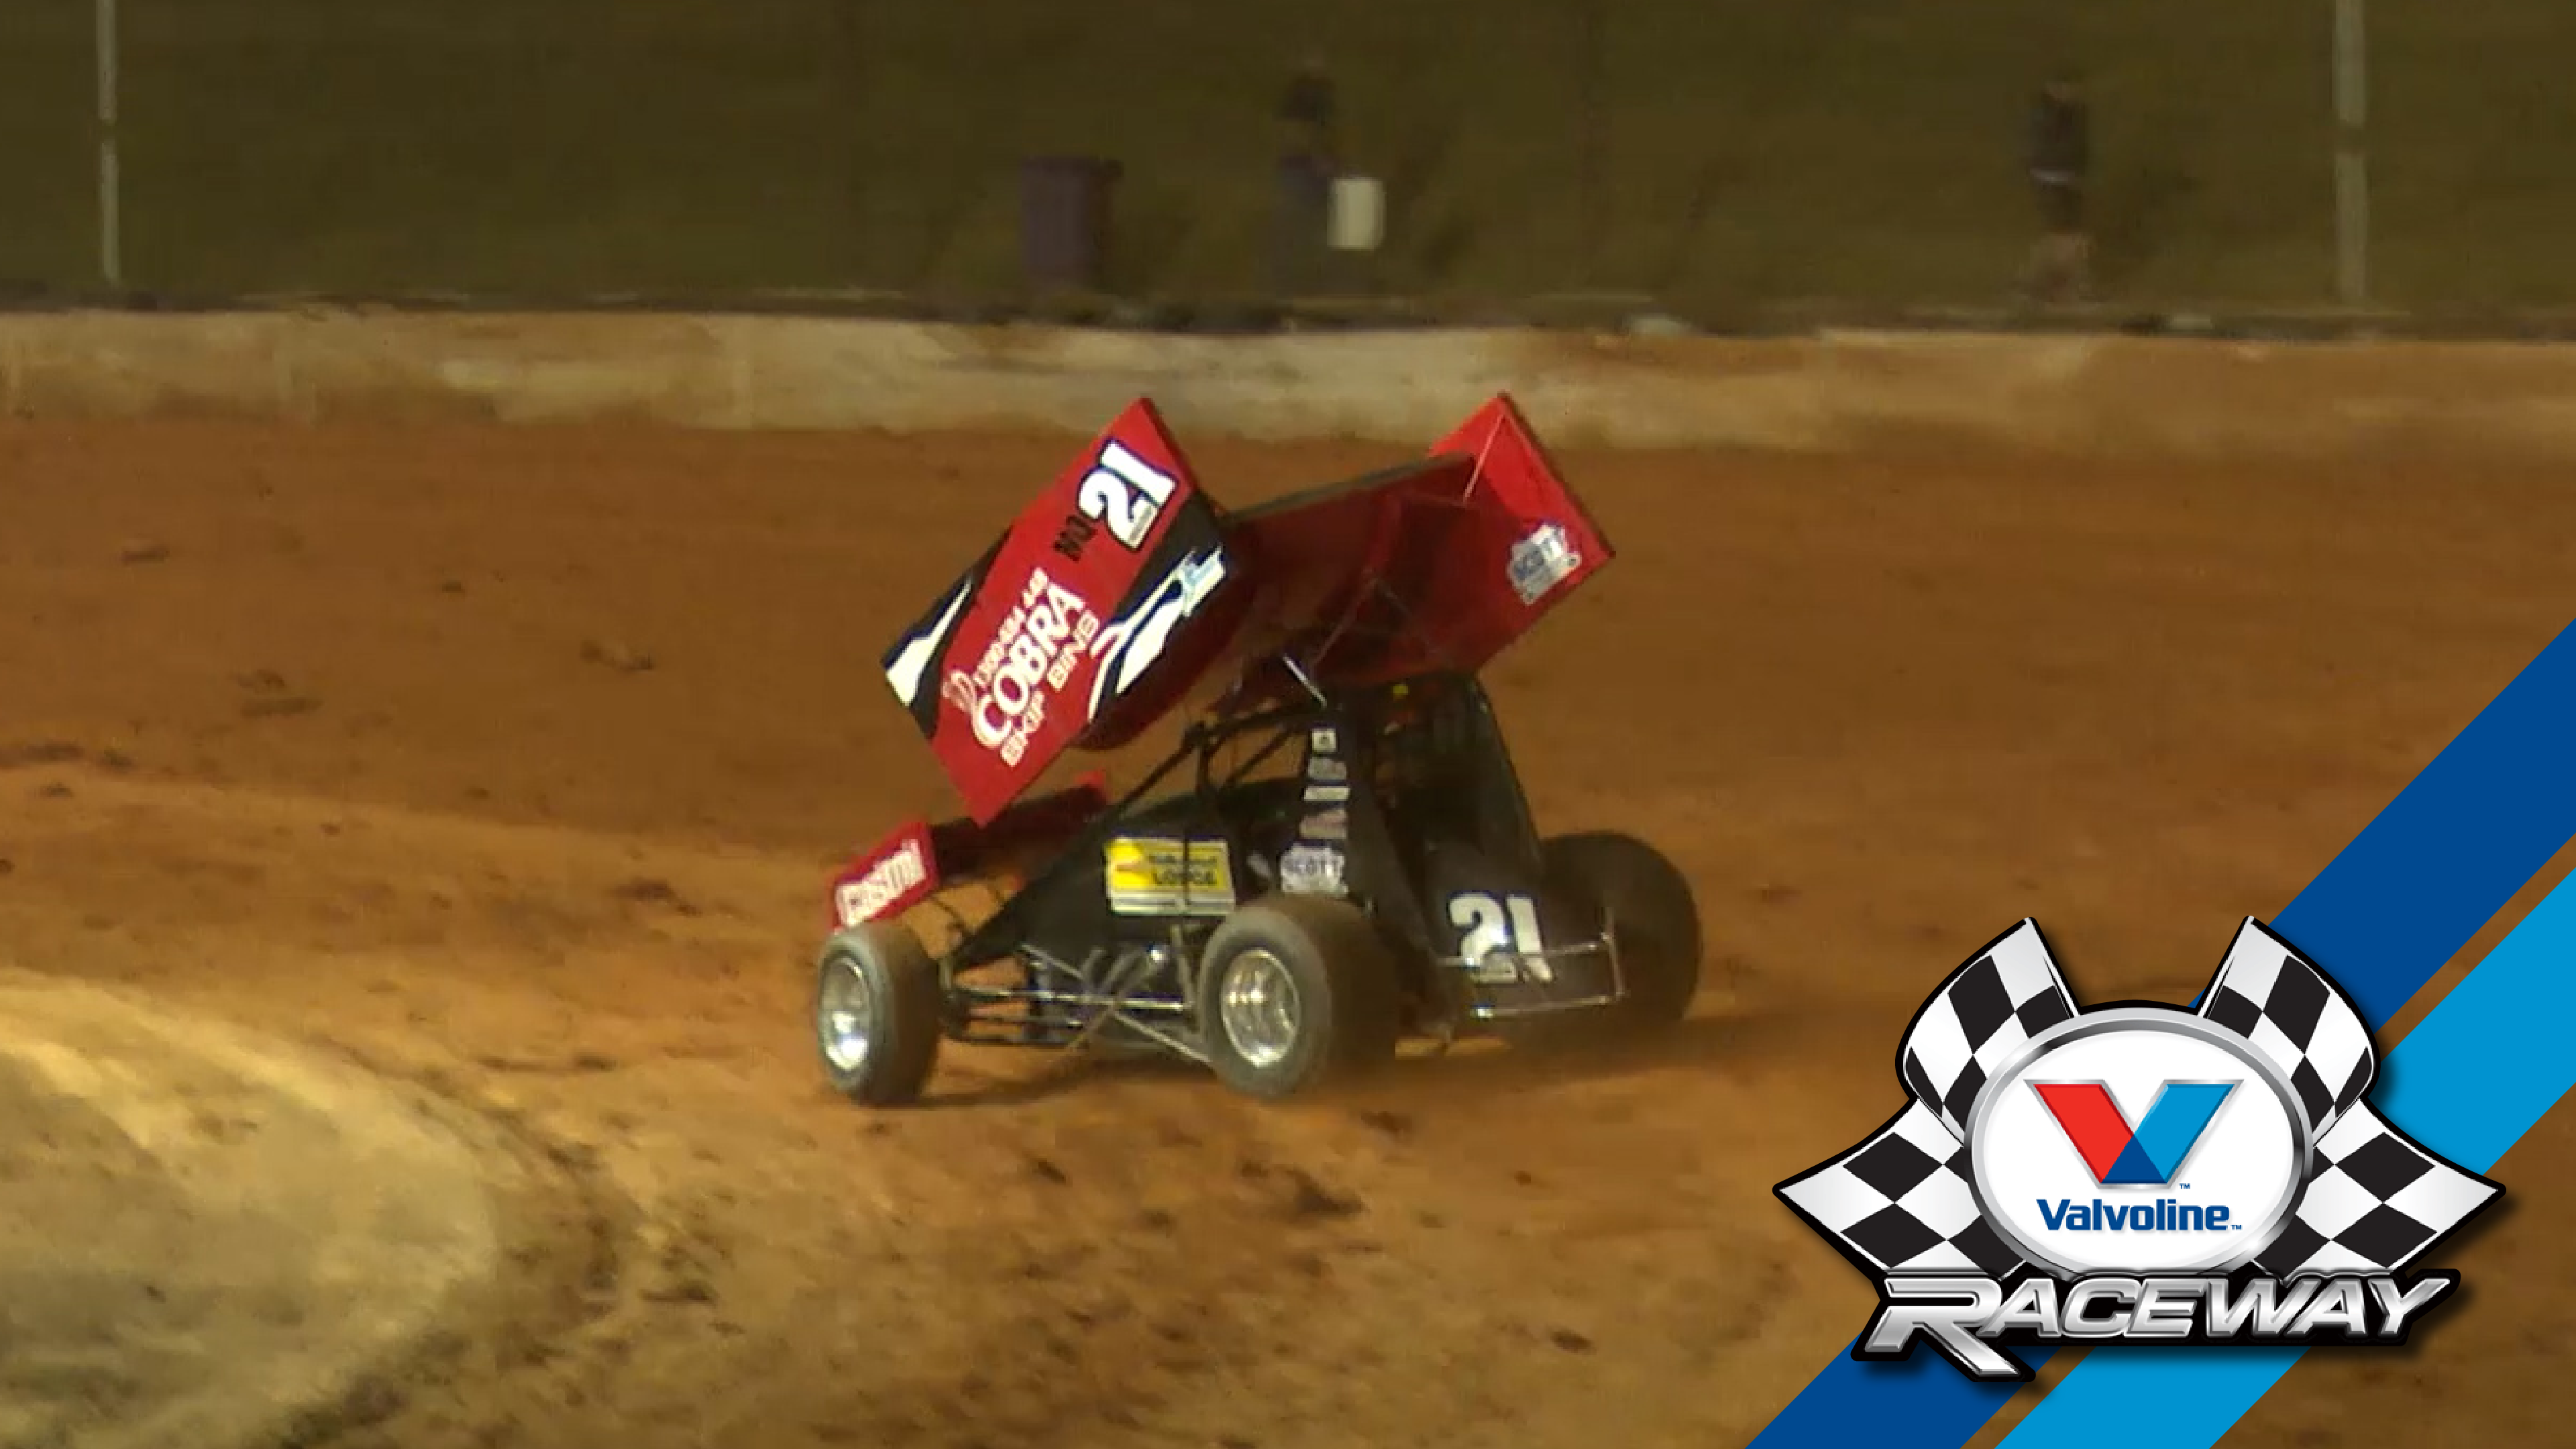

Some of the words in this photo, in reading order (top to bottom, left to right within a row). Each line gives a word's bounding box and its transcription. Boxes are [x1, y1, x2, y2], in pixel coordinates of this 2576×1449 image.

[1077, 439, 1178, 551] 21
[971, 582, 1087, 748] COBRA
[1000, 690, 1045, 767] SKIP
[1046, 608, 1100, 693] BINS
[1449, 892, 1552, 983] 21
